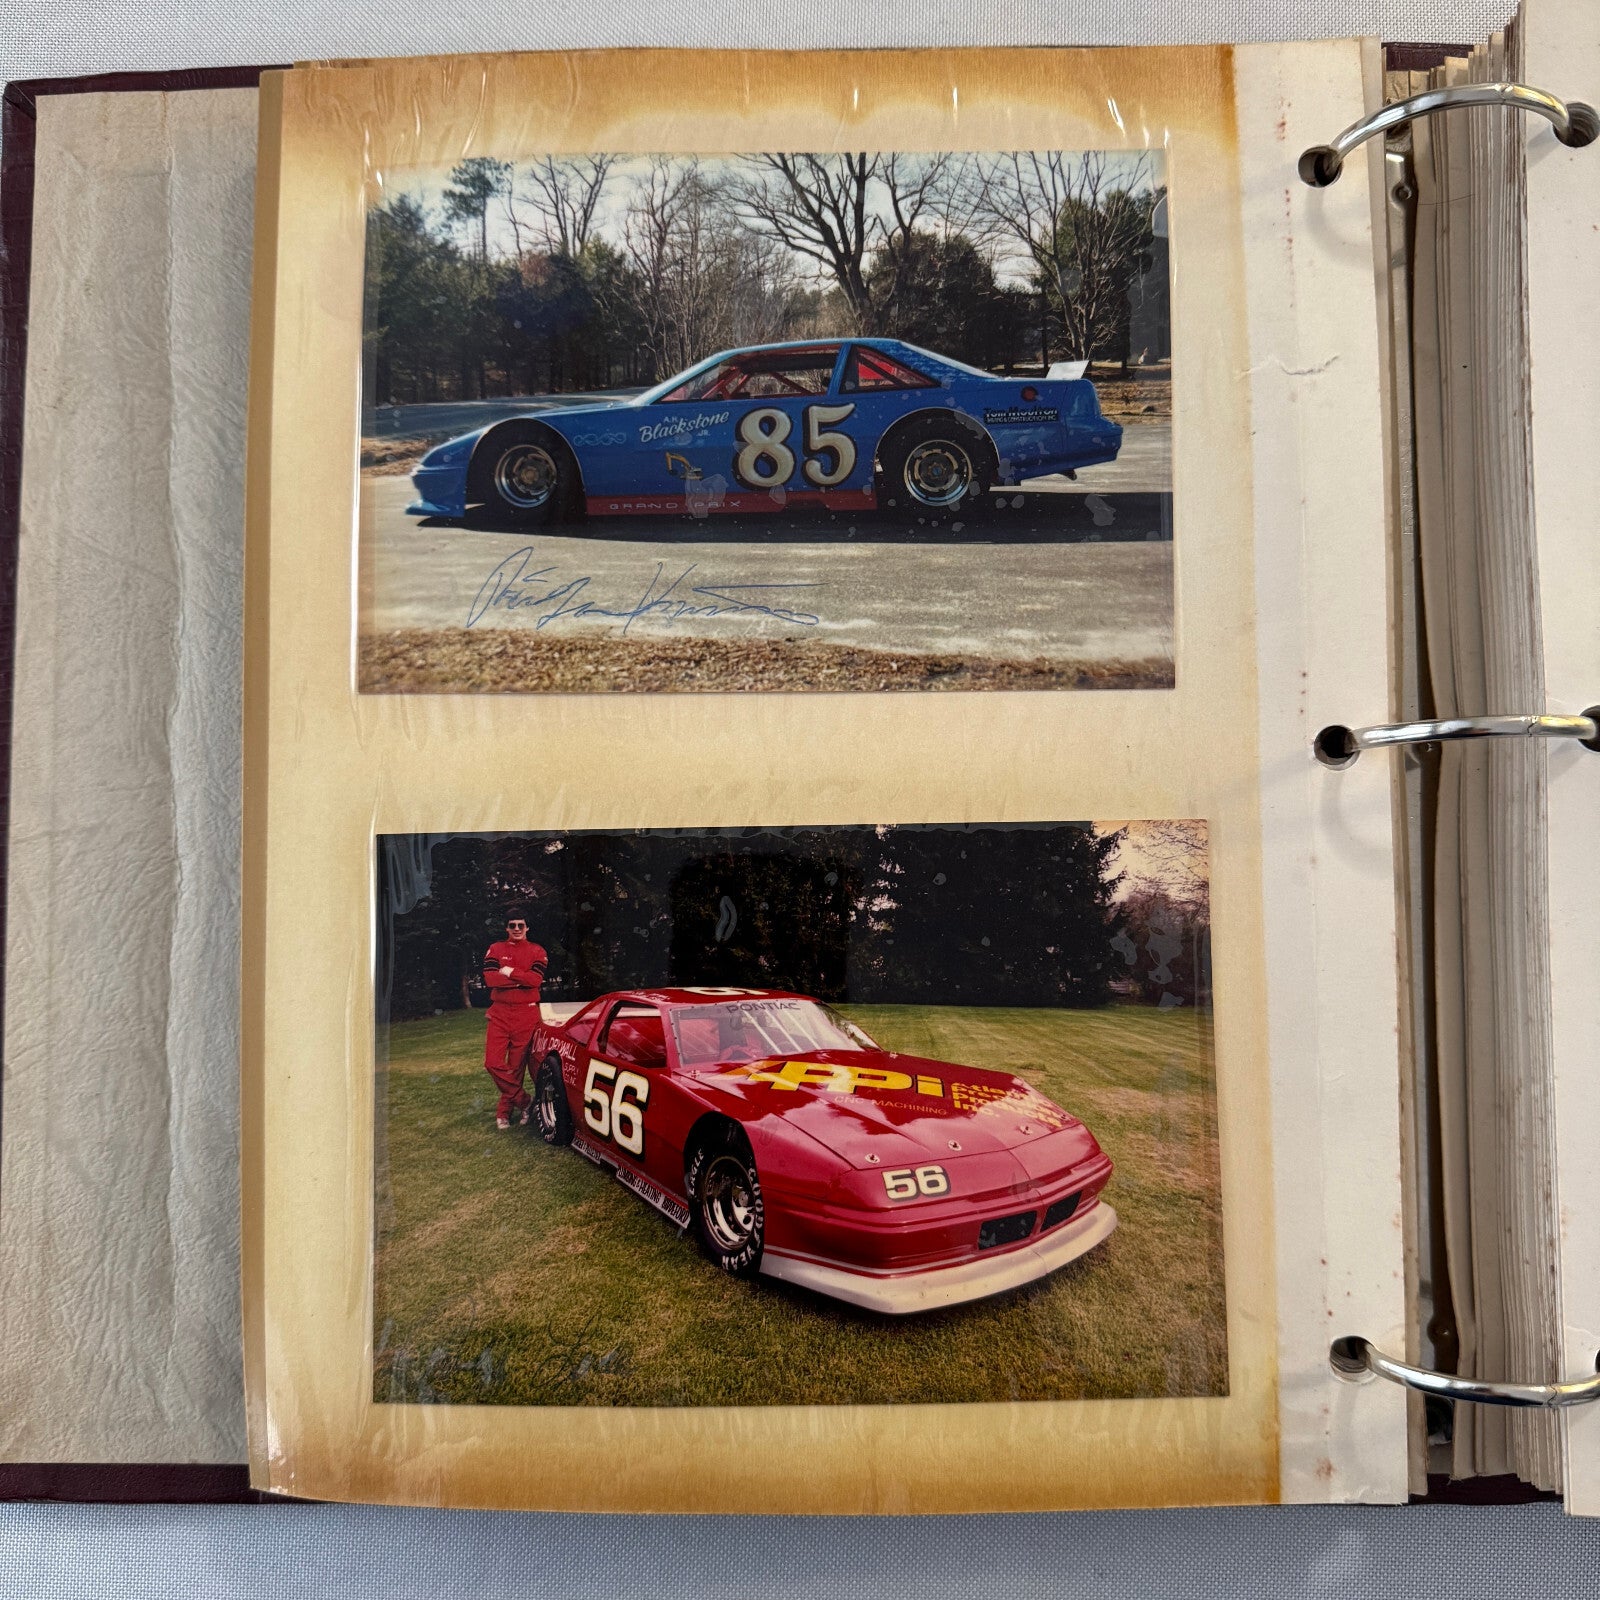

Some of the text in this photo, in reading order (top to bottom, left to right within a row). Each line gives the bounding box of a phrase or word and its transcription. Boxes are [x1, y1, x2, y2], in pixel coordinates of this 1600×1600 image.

[639, 411, 730, 443] Blackstone
[733, 402, 857, 489] 85
[609, 502, 678, 510] GRAND
[725, 1001, 801, 1014] PONTIAC
[583, 1057, 650, 1156] 56
[872, 1098, 947, 1116] MACHINING
[881, 1165, 951, 1201] 56
